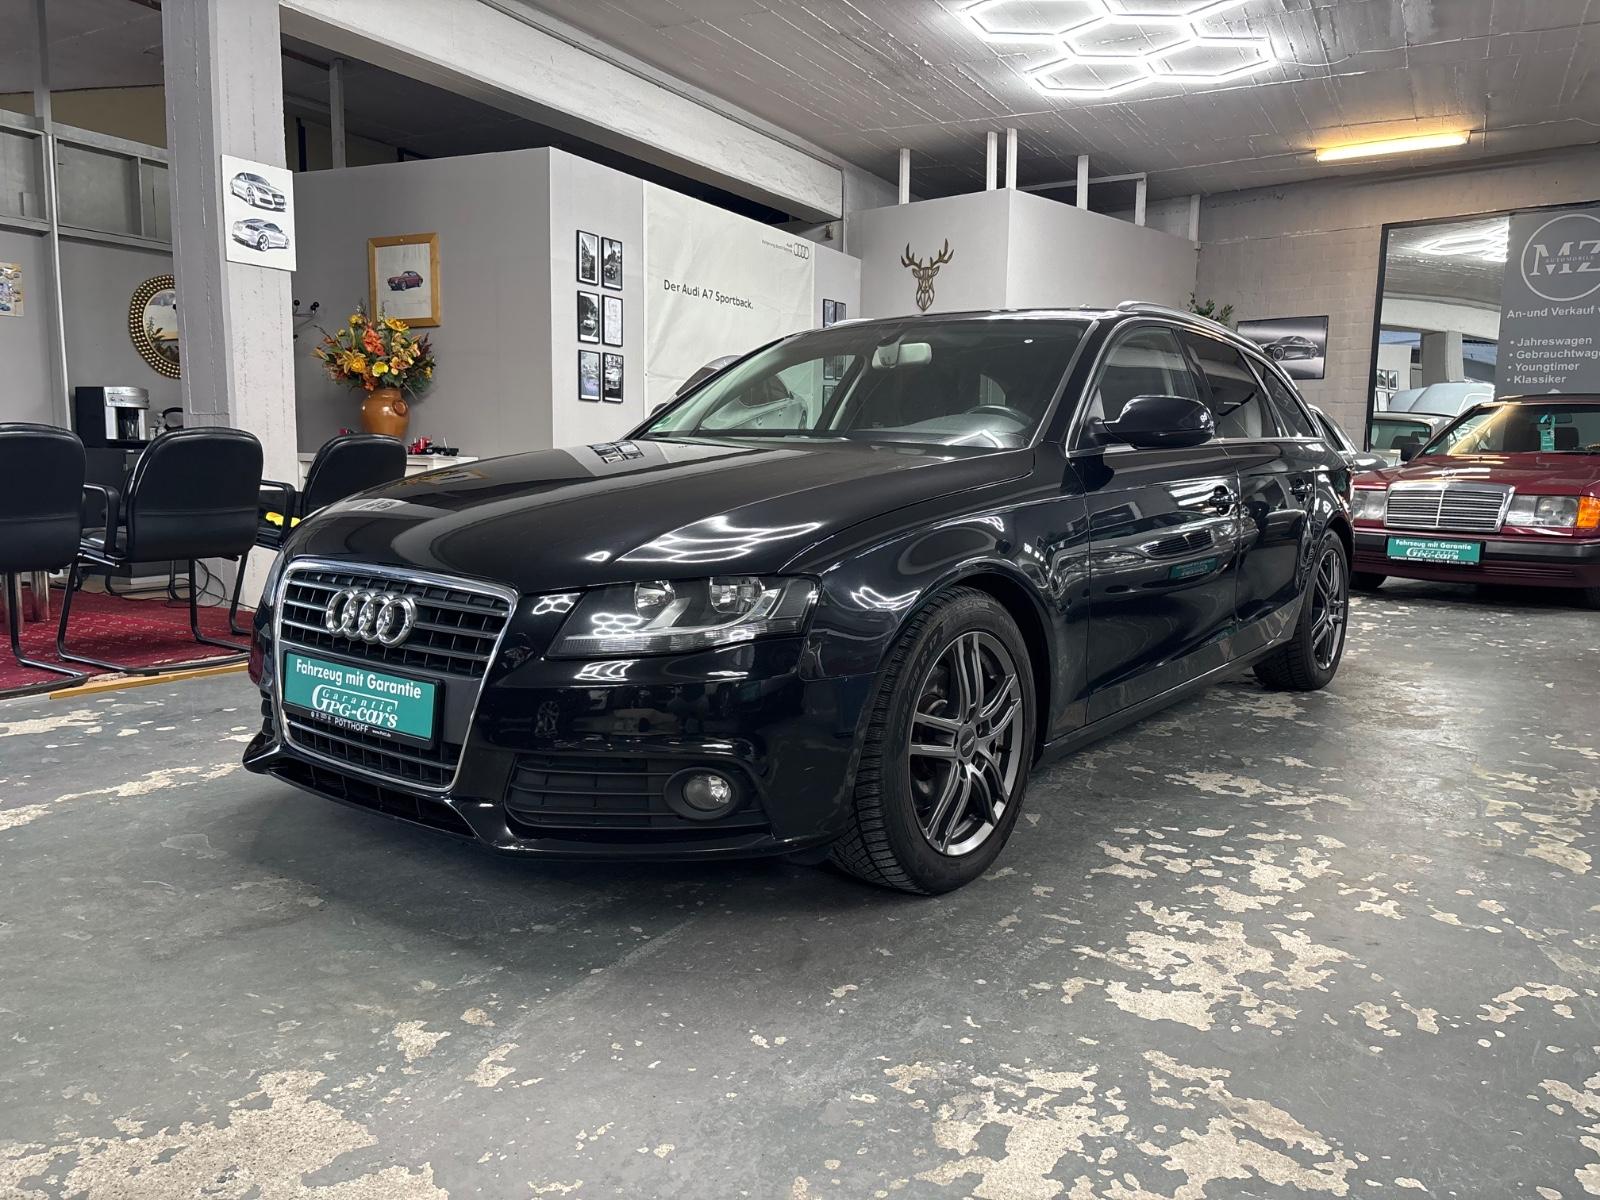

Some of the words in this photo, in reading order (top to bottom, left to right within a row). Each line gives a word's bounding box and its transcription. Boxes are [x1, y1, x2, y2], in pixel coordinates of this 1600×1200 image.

[1529, 241, 1600, 276] MZ
[663, 279, 681, 293] Der
[682, 283, 700, 298] Audi
[702, 288, 714, 301] A7
[715, 291, 753, 310] Sportback.
[1507, 307, 1548, 319] An-und
[1551, 305, 1595, 316] Verkauf
[1517, 337, 1593, 347] Jahreswagen
[1516, 349, 1600, 360] Gebrauchtwag
[1515, 362, 1580, 374] Youngtimer
[1513, 374, 1567, 385] Klassiker
[296, 659, 343, 685] Fahrzeug
[346, 671, 364, 686] mit
[367, 674, 422, 699] Garantie
[322, 688, 394, 713] Garantie
[334, 717, 369, 733] POTTHOFF
